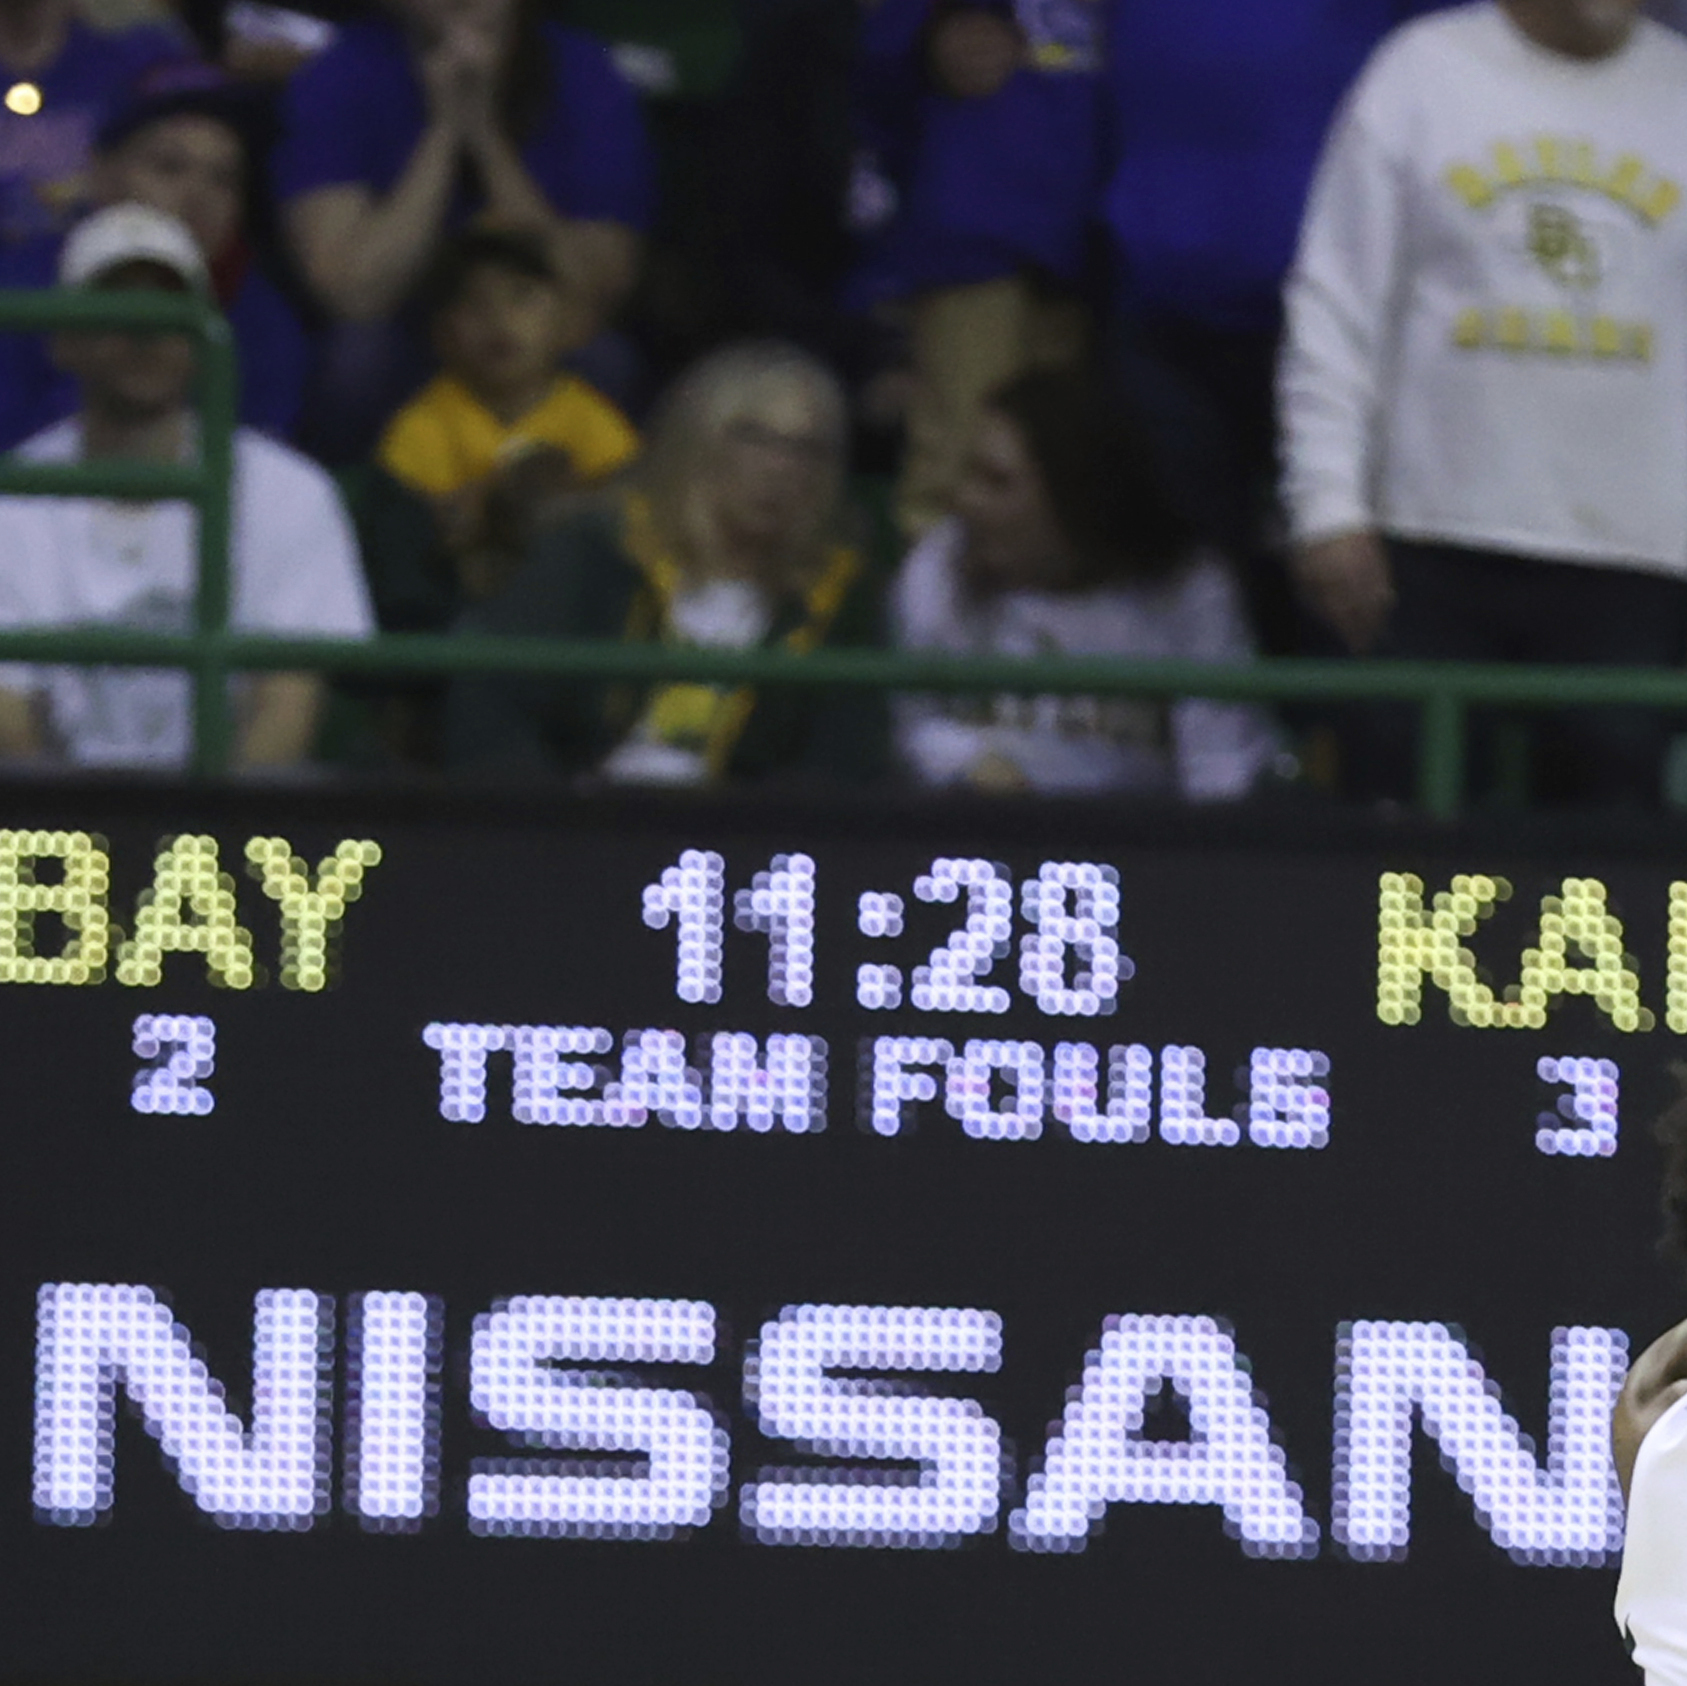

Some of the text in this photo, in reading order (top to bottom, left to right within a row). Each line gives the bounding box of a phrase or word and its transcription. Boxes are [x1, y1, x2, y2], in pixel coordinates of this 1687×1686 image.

[0, 829, 382, 992] BAY
[643, 849, 1134, 1016] 11:28
[131, 1014, 216, 1115] 2
[422, 1021, 1332, 1148] TEAM FOULS
[1535, 1056, 1619, 1156] 3
[33, 1283, 1630, 1568] NISSAN
